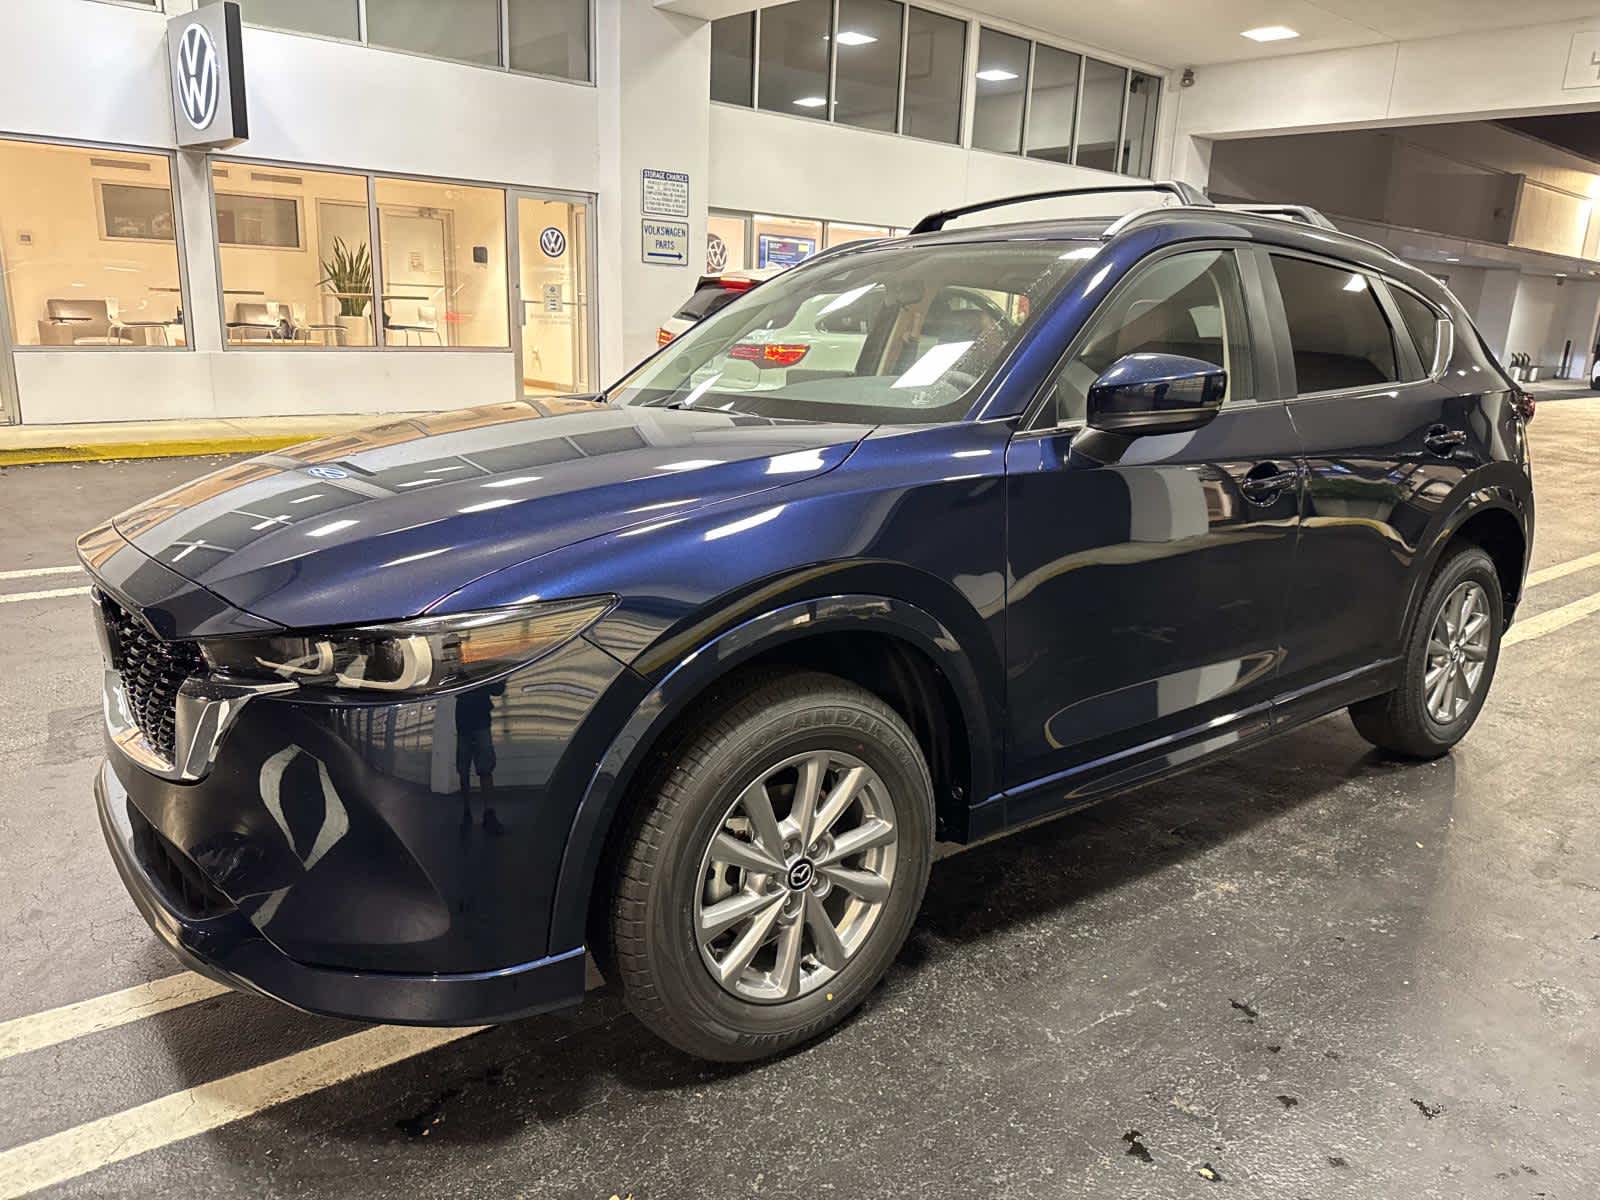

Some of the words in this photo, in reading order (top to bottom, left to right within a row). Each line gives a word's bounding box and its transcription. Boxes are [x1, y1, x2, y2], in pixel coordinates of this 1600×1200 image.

[644, 170, 665, 179] STORAGE
[644, 224, 686, 238] VOLKSWAGEN
[655, 239, 675, 250] PARTS
